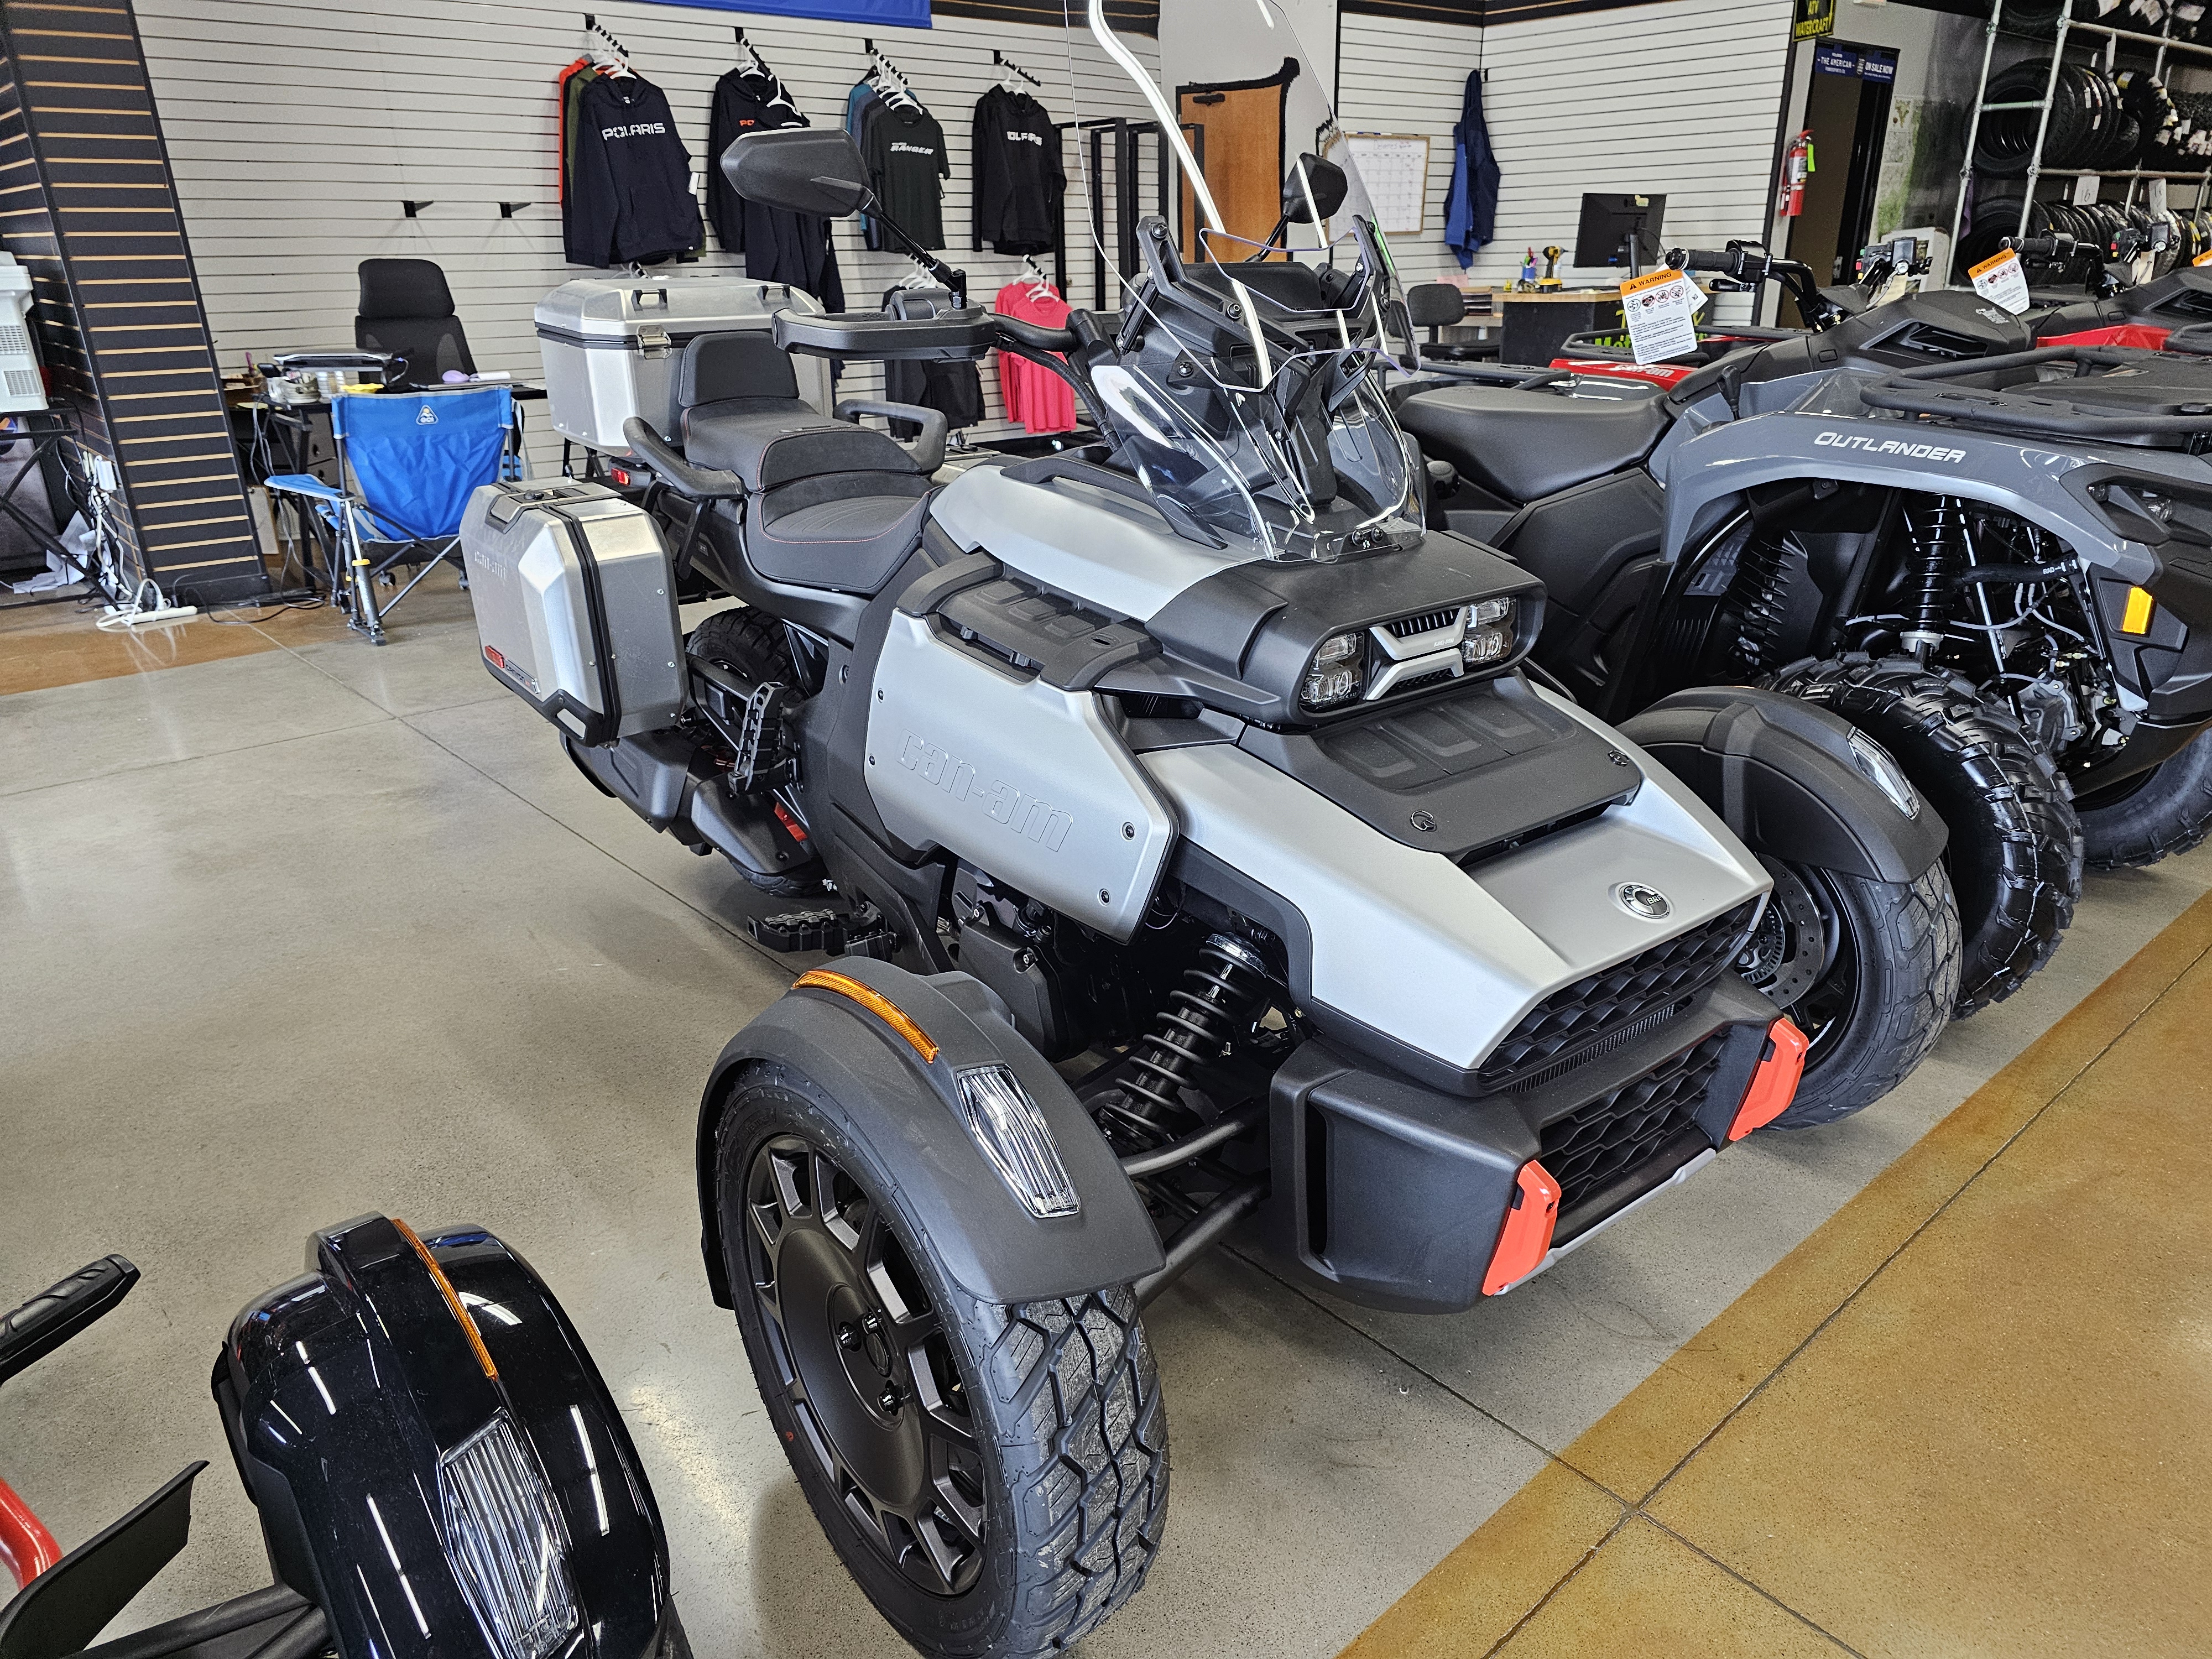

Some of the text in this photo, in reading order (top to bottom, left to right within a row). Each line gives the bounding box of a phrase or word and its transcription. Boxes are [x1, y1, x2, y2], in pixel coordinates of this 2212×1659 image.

[602, 123, 666, 140] POLARIS
[890, 145, 934, 155] RANGER
[1982, 254, 2007, 269] WARNING
[1639, 272, 1672, 286] WARNING
[1814, 432, 1966, 463] OUTLANDER
[895, 728, 1073, 852] can-am
